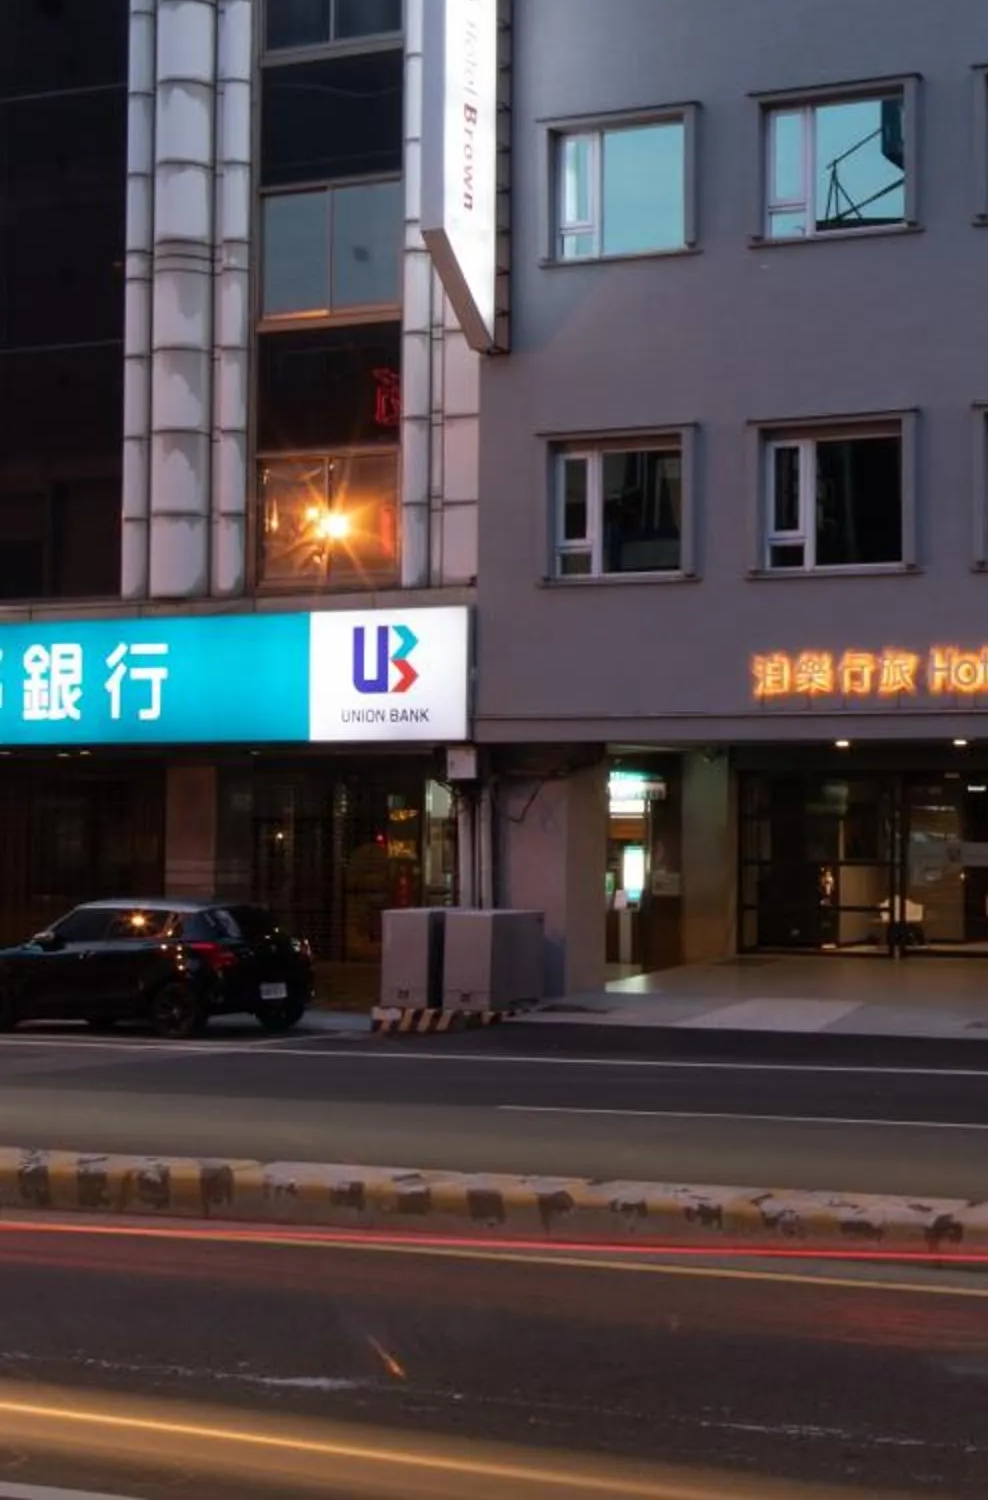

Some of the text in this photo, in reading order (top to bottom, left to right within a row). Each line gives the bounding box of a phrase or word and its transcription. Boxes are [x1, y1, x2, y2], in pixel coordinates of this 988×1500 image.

[463, 102, 478, 212] Brown
[0, 642, 169, 721] 銀行
[341, 707, 430, 723] UNION BANK
